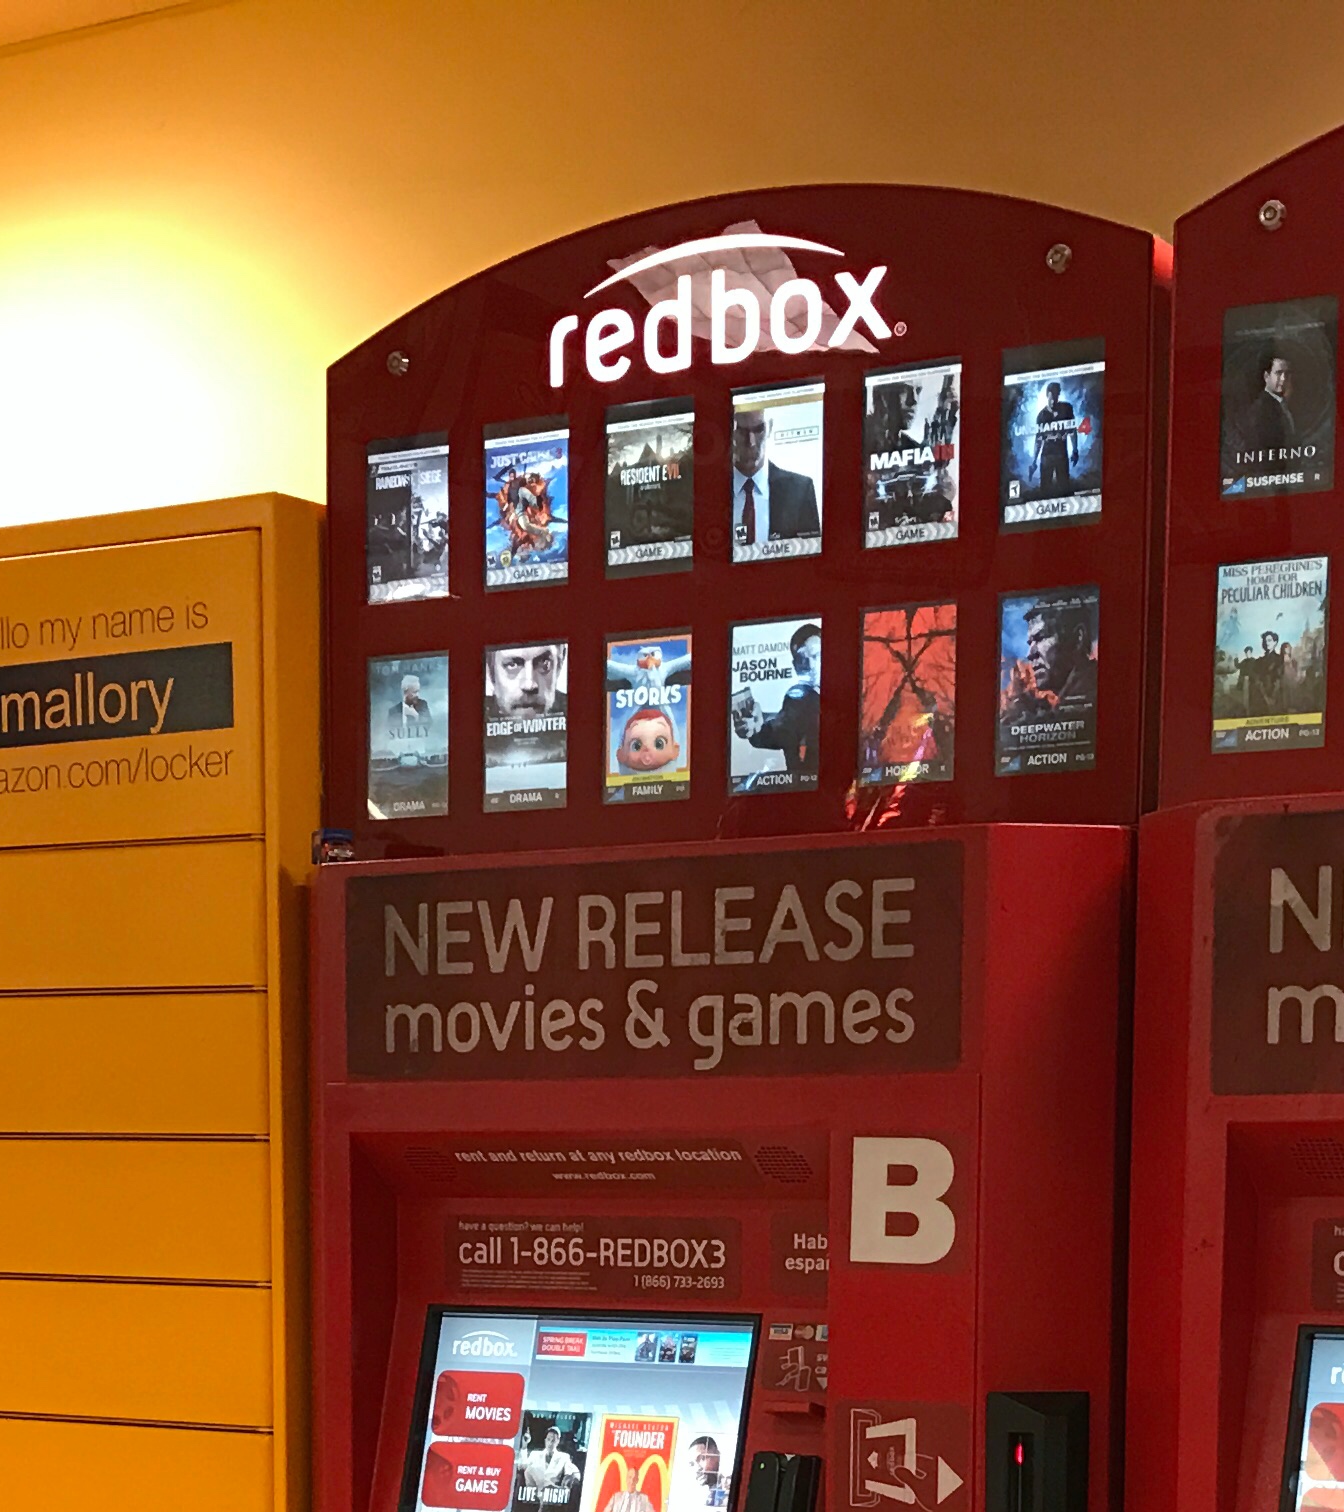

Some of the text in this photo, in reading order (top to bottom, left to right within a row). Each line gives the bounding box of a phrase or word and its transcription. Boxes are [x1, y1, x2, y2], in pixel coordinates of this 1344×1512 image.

[548, 265, 893, 388] redbox
[1236, 446, 1316, 464] INFERNO
[1246, 473, 1304, 488] SUSPENSE
[1036, 502, 1067, 515] GAME
[896, 528, 925, 540] GAME
[636, 547, 663, 558] GAME
[762, 544, 790, 555] GAME
[513, 569, 540, 579] GAME
[1221, 581, 1322, 604] PECULIAR CHILDREN
[40, 616, 82, 650] my
[92, 604, 174, 640] name
[186, 599, 209, 630] is
[732, 657, 777, 673] JASON
[739, 667, 793, 683] BOURNE
[1, 671, 174, 734] mallory
[615, 684, 682, 709] STORKS
[486, 720, 513, 737] EDGE
[523, 718, 567, 734] WINTER
[1010, 720, 1085, 736] DEEPWATER
[1244, 727, 1290, 743] ACTION
[1019, 730, 1077, 744] HORIZON
[1027, 753, 1067, 766] ACTION
[756, 774, 793, 786] ACTION
[509, 792, 543, 804] DRAMA
[632, 785, 664, 796] FAMILY
[393, 801, 425, 813] DRAMA
[384, 877, 915, 976] NEW RELEASE
[385, 979, 915, 1070] movies & games
[849, 1136, 955, 1264] B
[459, 1236, 726, 1269] call 1-866-REDBOX3
[452, 1336, 515, 1357] redbox
[467, 1393, 487, 1403] RENT
[465, 1406, 512, 1422] MOVIES
[613, 1430, 665, 1449] FOUNDER
[455, 1478, 499, 1494] GAMES
